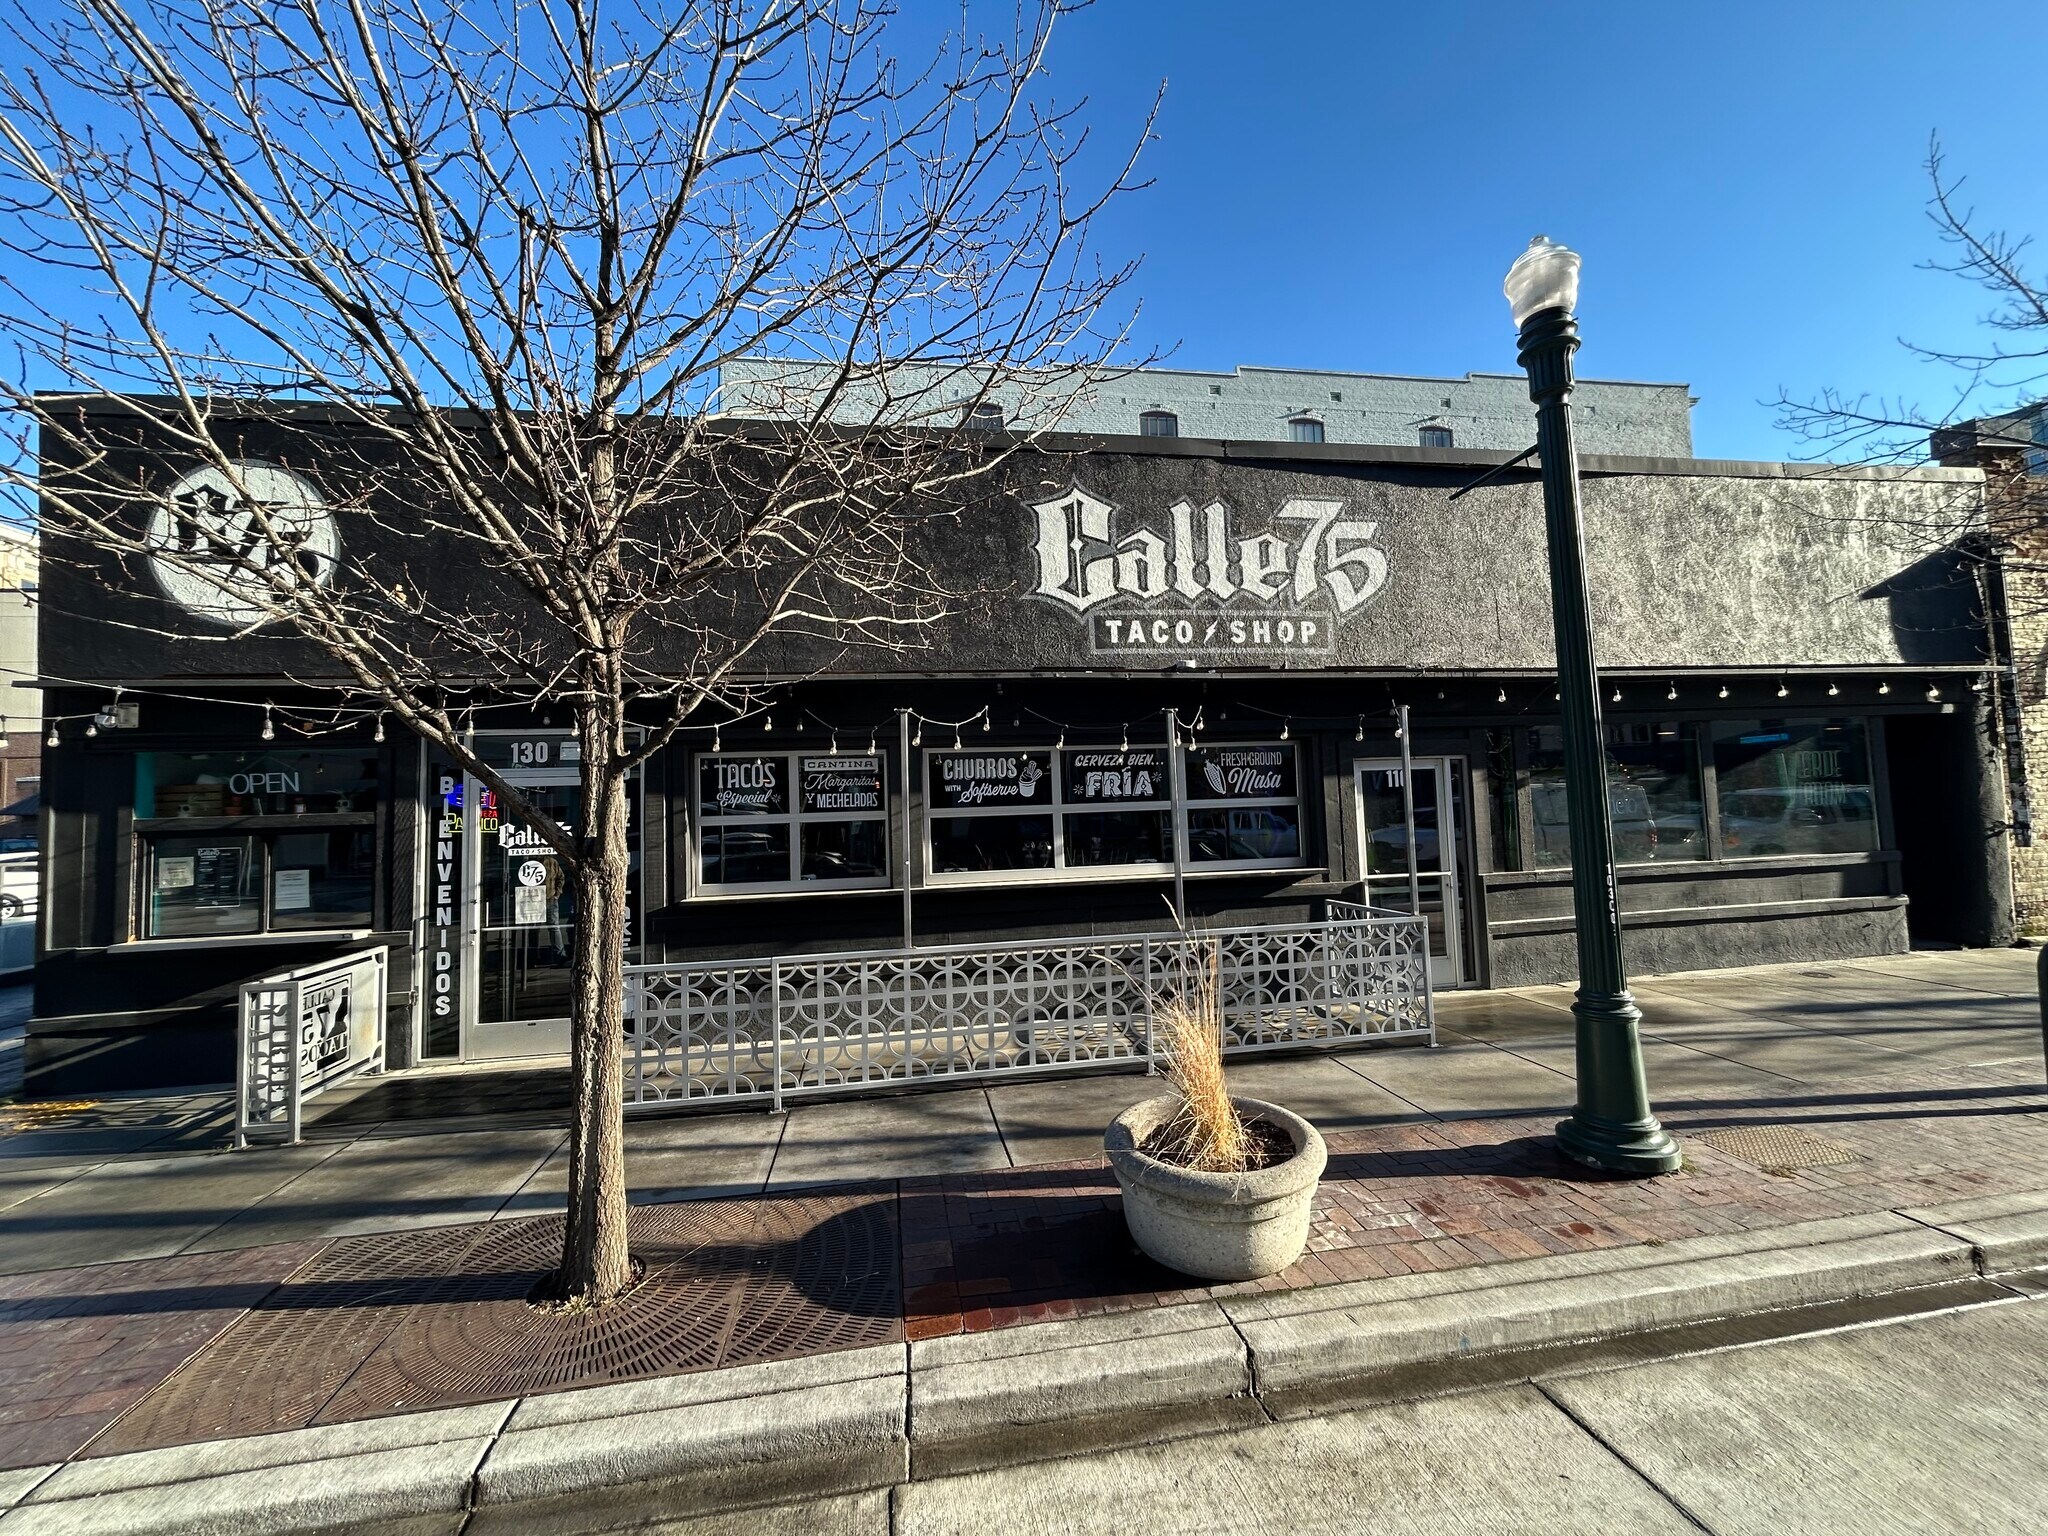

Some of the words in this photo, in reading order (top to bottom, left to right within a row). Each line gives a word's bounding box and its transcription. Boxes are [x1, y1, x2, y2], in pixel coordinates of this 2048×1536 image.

[1104, 619, 1193, 644] TACO
[1230, 619, 1317, 644] SHOP
[510, 741, 549, 763] 130
[1074, 754, 1124, 767] CERVEZA
[807, 760, 875, 769] CANTINA
[942, 757, 1018, 781] CHURROS
[229, 771, 300, 795] OPEN
[714, 763, 776, 789] TACOS
[804, 773, 876, 792] Margaritas
[1227, 767, 1282, 794] Masa
[716, 790, 773, 808] Especial
[806, 793, 816, 804] Y
[817, 793, 878, 808] MECHELADAS
[944, 785, 962, 793] WITH
[958, 781, 1019, 803] Softserve
[435, 776, 455, 1016] BIENVENIDOS
